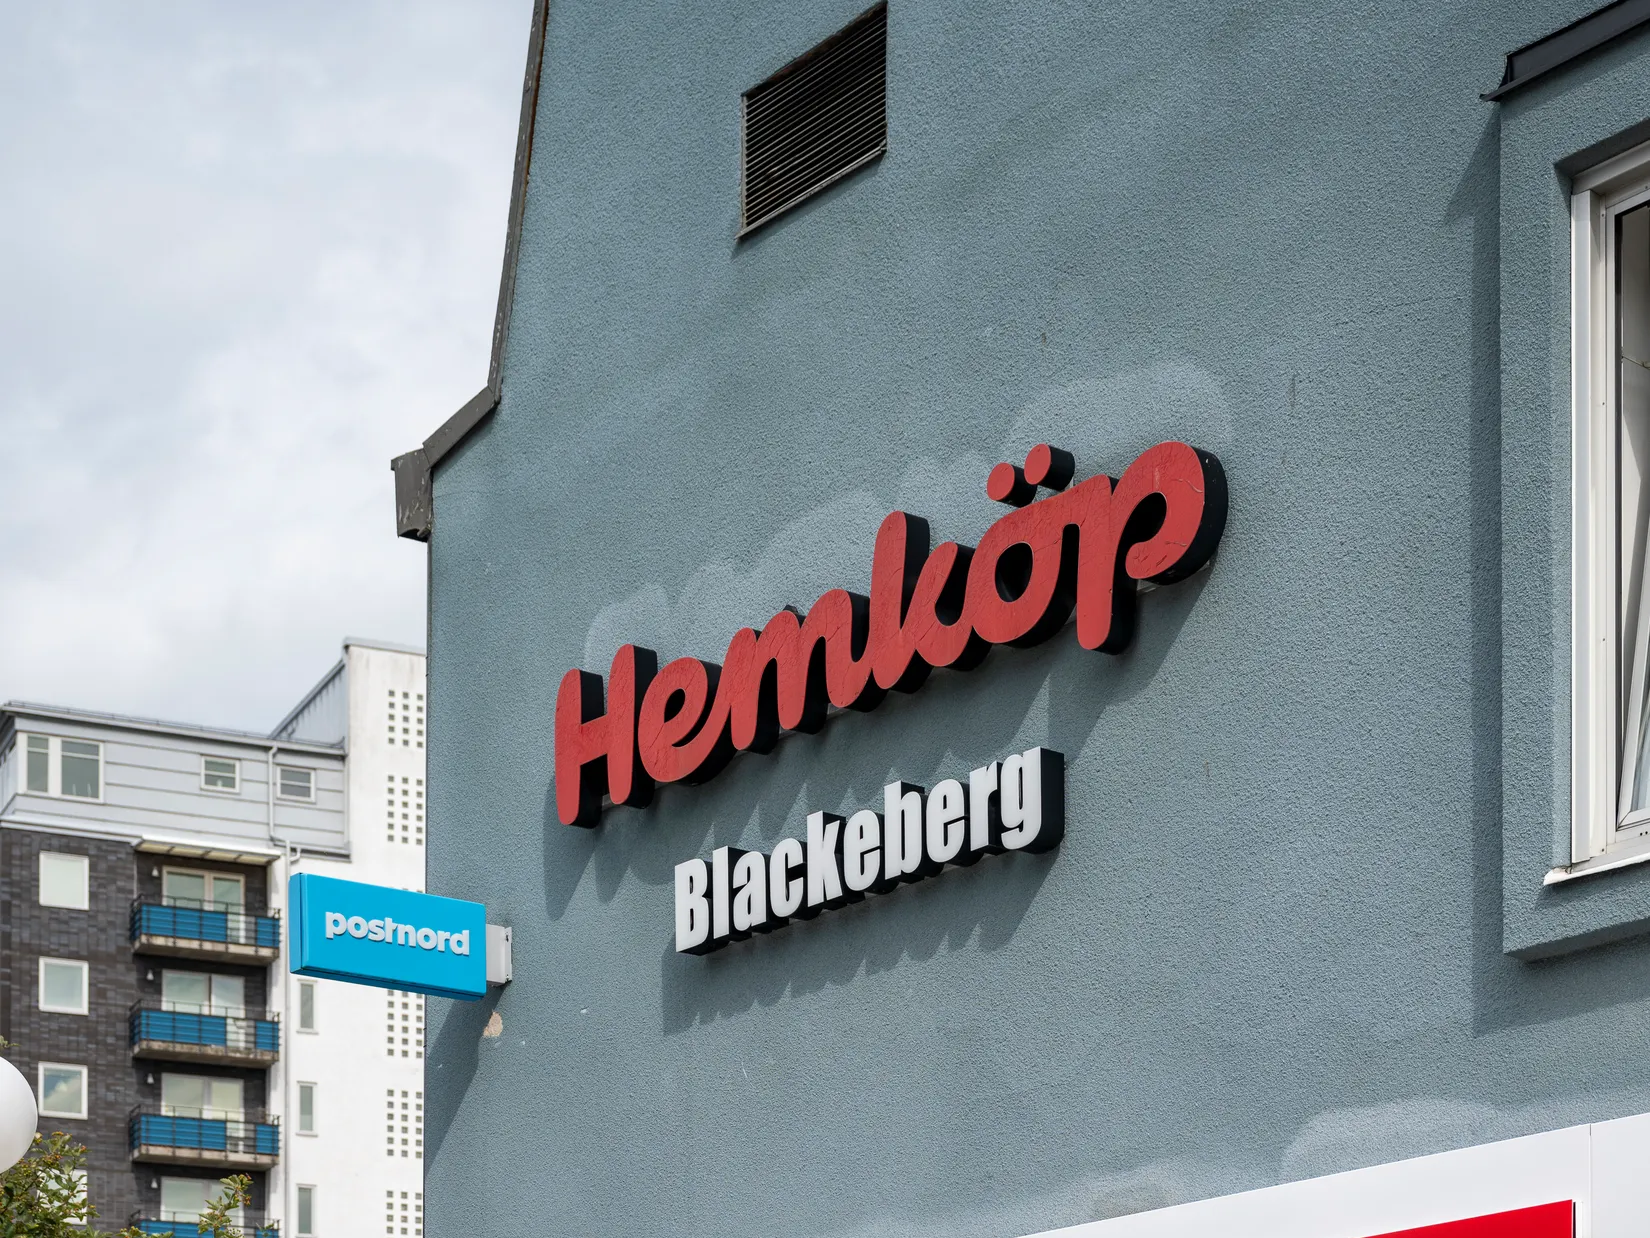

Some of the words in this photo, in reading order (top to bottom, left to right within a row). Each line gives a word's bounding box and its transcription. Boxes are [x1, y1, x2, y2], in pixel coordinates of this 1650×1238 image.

[555, 441, 1212, 827] Hemköp
[325, 911, 470, 956] postnord
[674, 746, 1049, 953] Blackeberg
